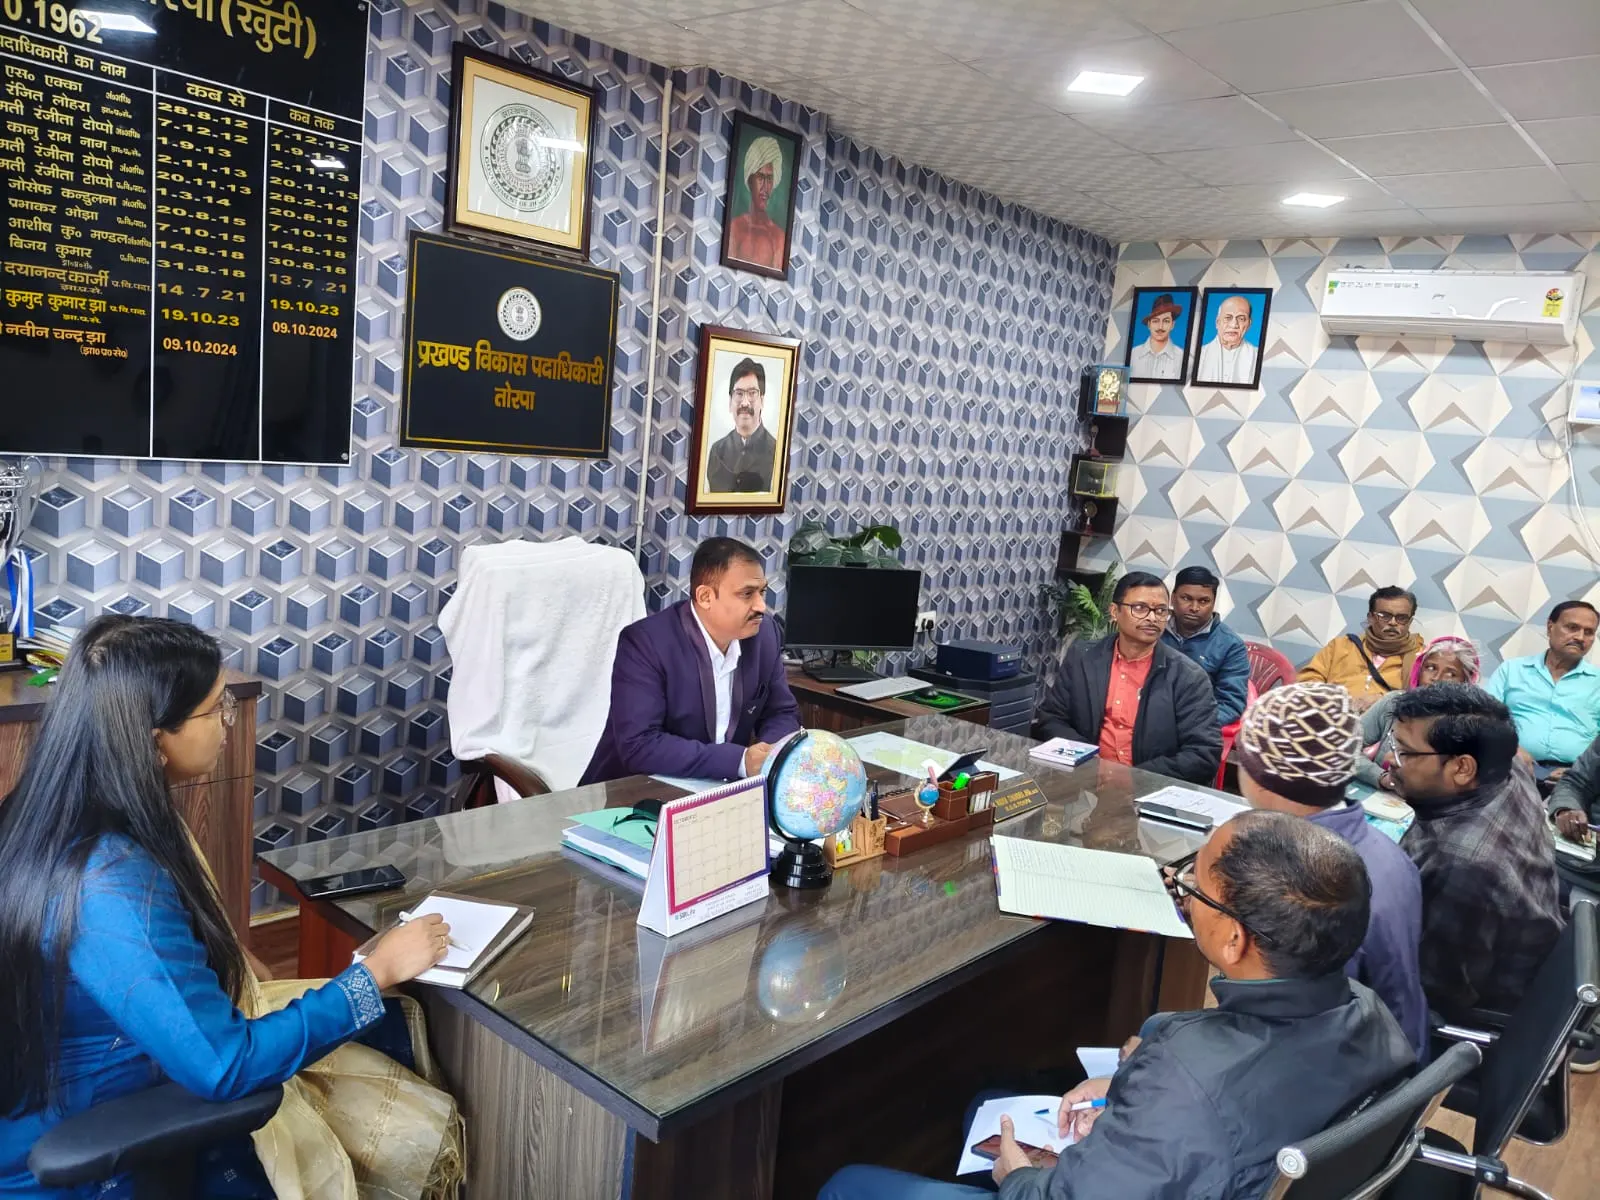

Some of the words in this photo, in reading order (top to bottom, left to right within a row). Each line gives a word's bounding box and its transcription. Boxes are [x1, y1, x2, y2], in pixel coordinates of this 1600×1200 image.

[74, 54, 94, 70] का
[100, 60, 126, 78] नाम
[52, 93, 90, 112] लोहरा
[186, 82, 222, 103] कब
[228, 89, 246, 108] से
[34, 105, 74, 126] रंजीता
[82, 116, 113, 134] टोप्पो
[158, 102, 248, 128] 28.8.12
[289, 109, 310, 124] कब
[314, 116, 335, 131] तक
[48, 129, 72, 143] राम
[80, 136, 107, 151] नाग
[158, 118, 248, 144] 7.12.12
[270, 127, 350, 152] 7.12.12
[34, 142, 74, 163] रंजीता
[82, 152, 113, 170] टोप्पो
[157, 137, 232, 158] 1.9.13
[34, 162, 74, 181] रंजीता
[82, 170, 113, 189] टोप्पो
[157, 154, 248, 178] 2.11.13
[271, 159, 350, 182] 2.11.13
[8, 176, 53, 195] जोसेफ
[157, 171, 252, 195] 20.11.13
[270, 176, 359, 200] 20.11.13
[156, 187, 231, 207] 1.3.14
[269, 192, 349, 213] 28.2.14
[65, 205, 99, 221] ओझा
[157, 205, 247, 226] 20.8.15
[269, 207, 349, 228] 20.8.15
[55, 243, 93, 259] कुमार
[156, 241, 245, 260] 14.8.18
[269, 241, 347, 260] 14.8.18
[4, 261, 67, 282] दयानन्द
[156, 259, 246, 278] 31.8.18
[269, 257, 347, 275] 30.8.18
[5, 289, 43, 309] कुमुद
[48, 294, 87, 312] कुमार
[88, 298, 107, 314] झा
[270, 298, 340, 316] 19.10.23
[161, 308, 240, 327] 19.10.23
[5, 320, 49, 339] नवीन
[53, 328, 84, 343] चन्द्र
[86, 331, 106, 345] झा
[272, 321, 338, 340] 09.10.2024
[163, 337, 238, 356] 09.10.2024
[417, 340, 472, 371] प्रखण्ड
[475, 339, 528, 376] विकास
[532, 351, 604, 385] पदाधिकारी
[494, 380, 535, 410] तोरपा
